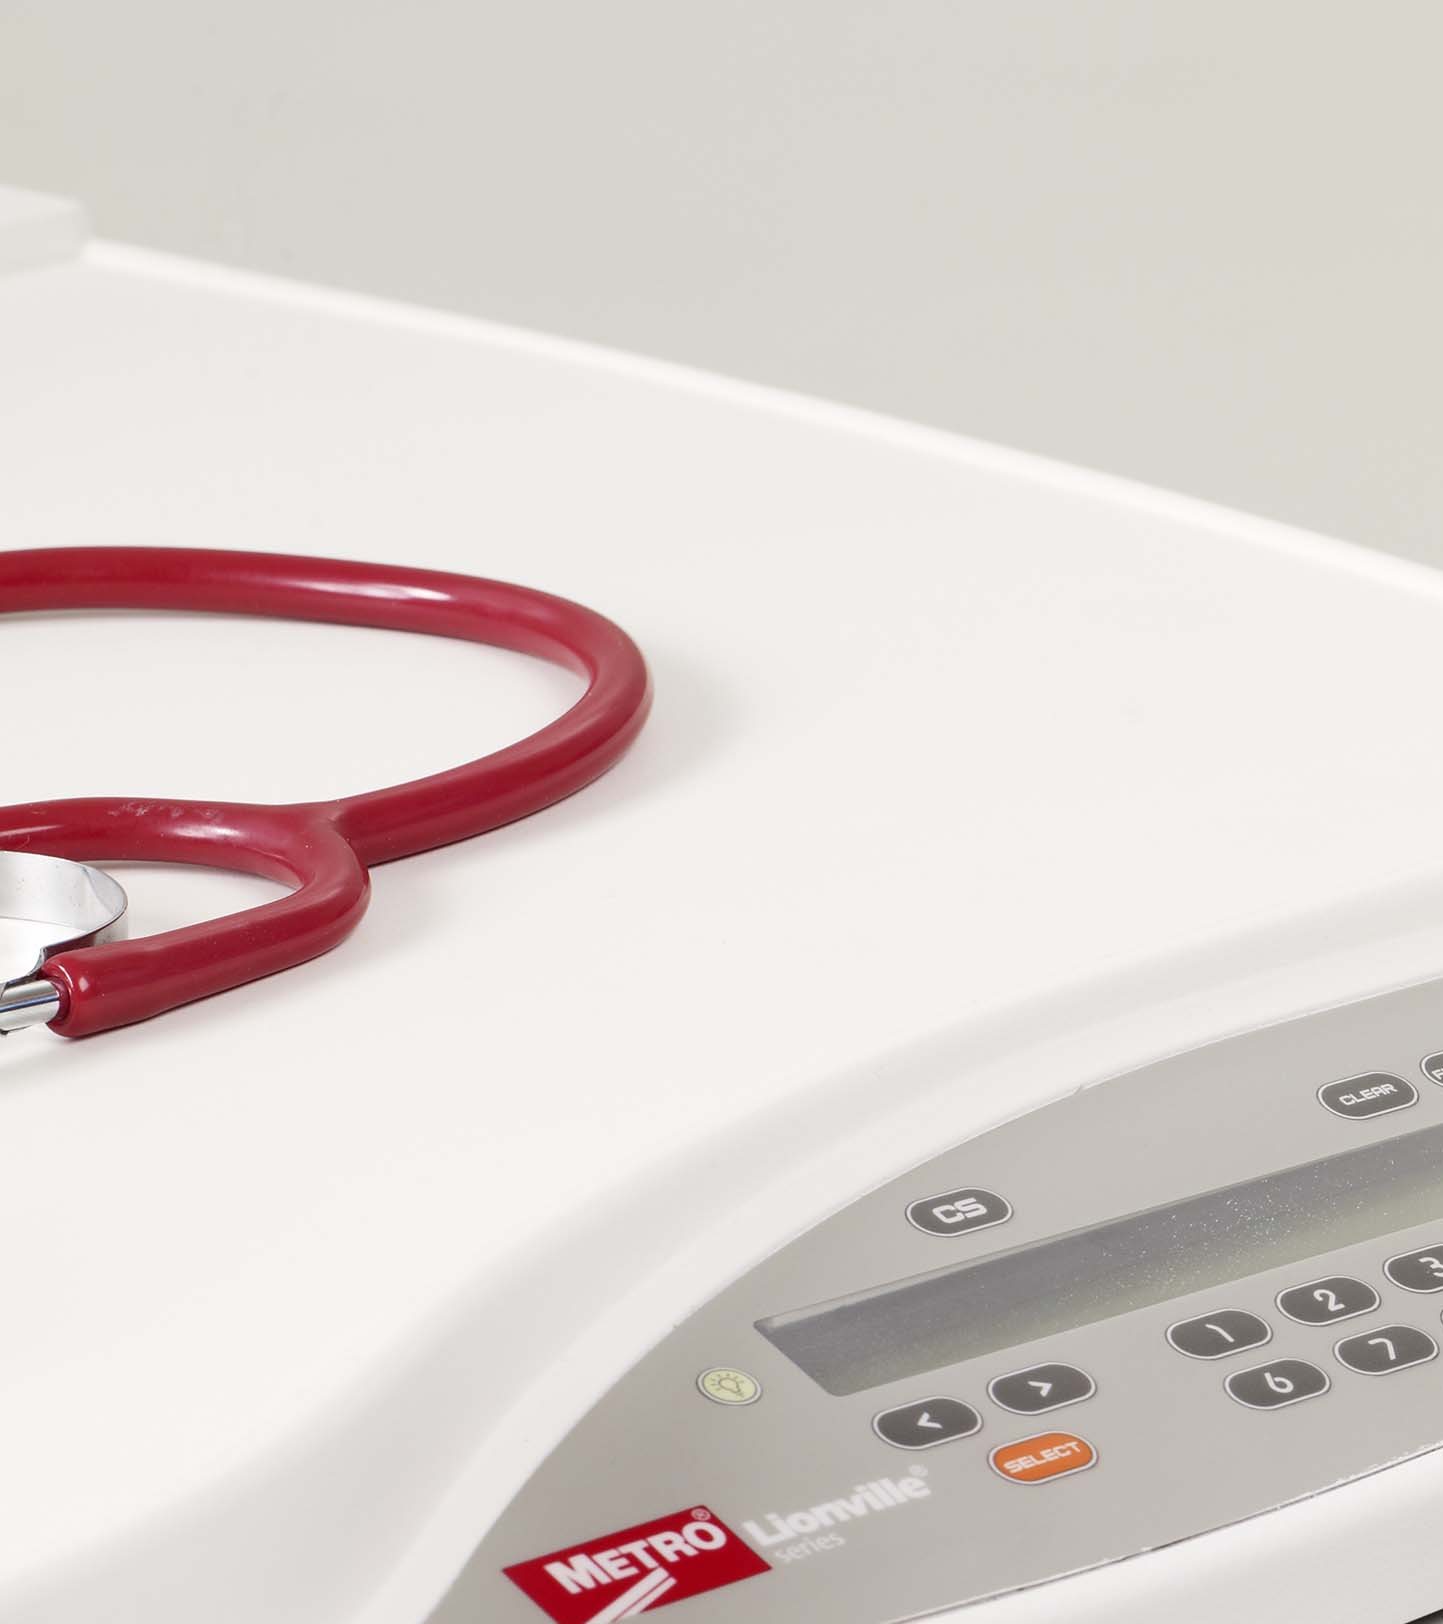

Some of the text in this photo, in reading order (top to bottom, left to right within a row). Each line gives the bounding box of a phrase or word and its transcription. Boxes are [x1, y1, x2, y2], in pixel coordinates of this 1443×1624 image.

[1339, 1082, 1399, 1106] CLEAR
[932, 1198, 988, 1223] CS
[1313, 1288, 1345, 1312] 2
[1204, 1323, 1235, 1343] 1
[1368, 1337, 1397, 1361] 7
[1264, 1372, 1294, 1394] 6
[1004, 1440, 1082, 1474] SELECT
[775, 1532, 847, 1564] series
